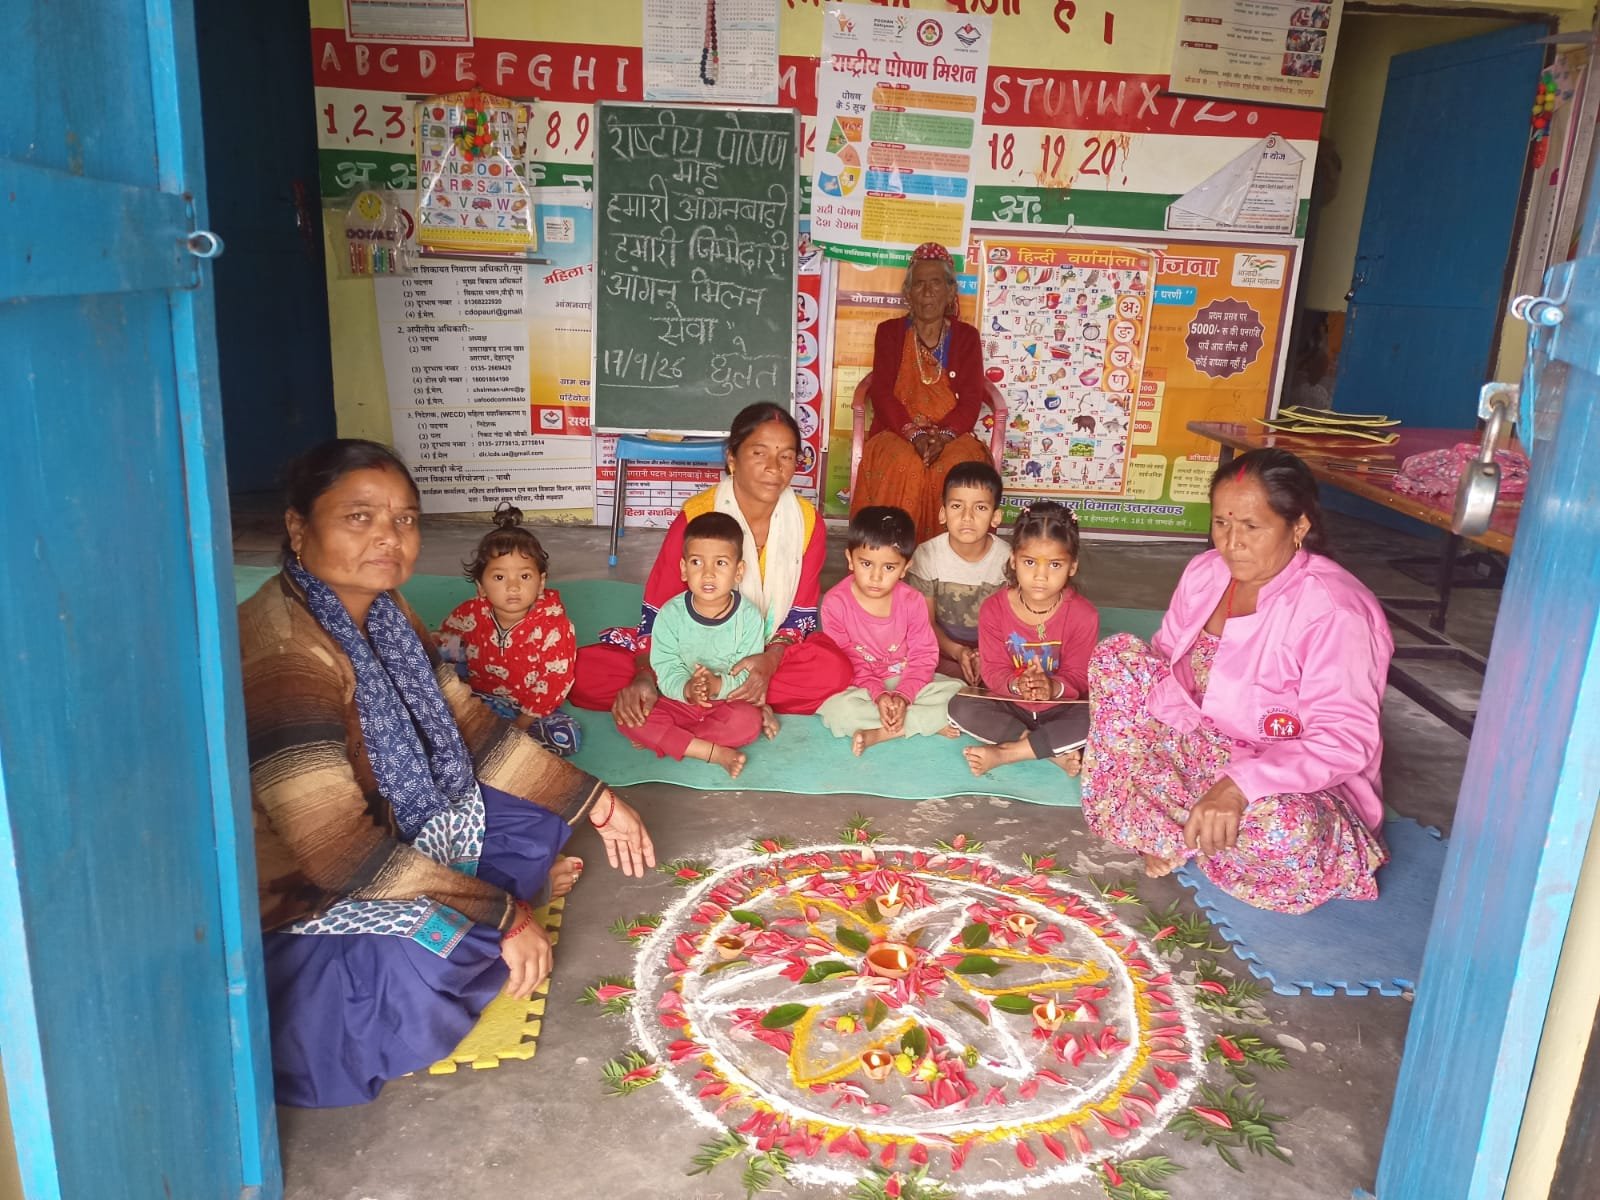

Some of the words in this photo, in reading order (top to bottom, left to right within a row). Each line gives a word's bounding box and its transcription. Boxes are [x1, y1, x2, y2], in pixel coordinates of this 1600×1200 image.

[320, 41, 342, 72] A
[355, 44, 370, 77] B
[379, 47, 400, 74] C
[418, 49, 437, 79] D
[455, 52, 477, 82] E
[496, 51, 518, 86] F
[528, 53, 553, 91] G
[572, 55, 597, 91] H
[616, 57, 629, 93] I
[832, 48, 881, 78] राष्ट्रीय
[886, 52, 929, 80] पोषण
[933, 55, 979, 84] मिशन
[991, 75, 1012, 114] S
[1017, 77, 1044, 114] T
[1043, 77, 1066, 116] U
[1072, 79, 1093, 117] V
[1097, 79, 1127, 117] W
[1137, 82, 1161, 120] X
[607, 174, 669, 224] हमारी
[608, 225, 685, 269] हमारी
[1017, 247, 1057, 265] हिन्दी
[1067, 250, 1138, 267] वर्णमाला
[542, 264, 585, 285] महिला
[688, 266, 769, 316] मिलन
[1083, 498, 1121, 512] विभाग
[1124, 502, 1185, 516] उत्तराखण्ड
